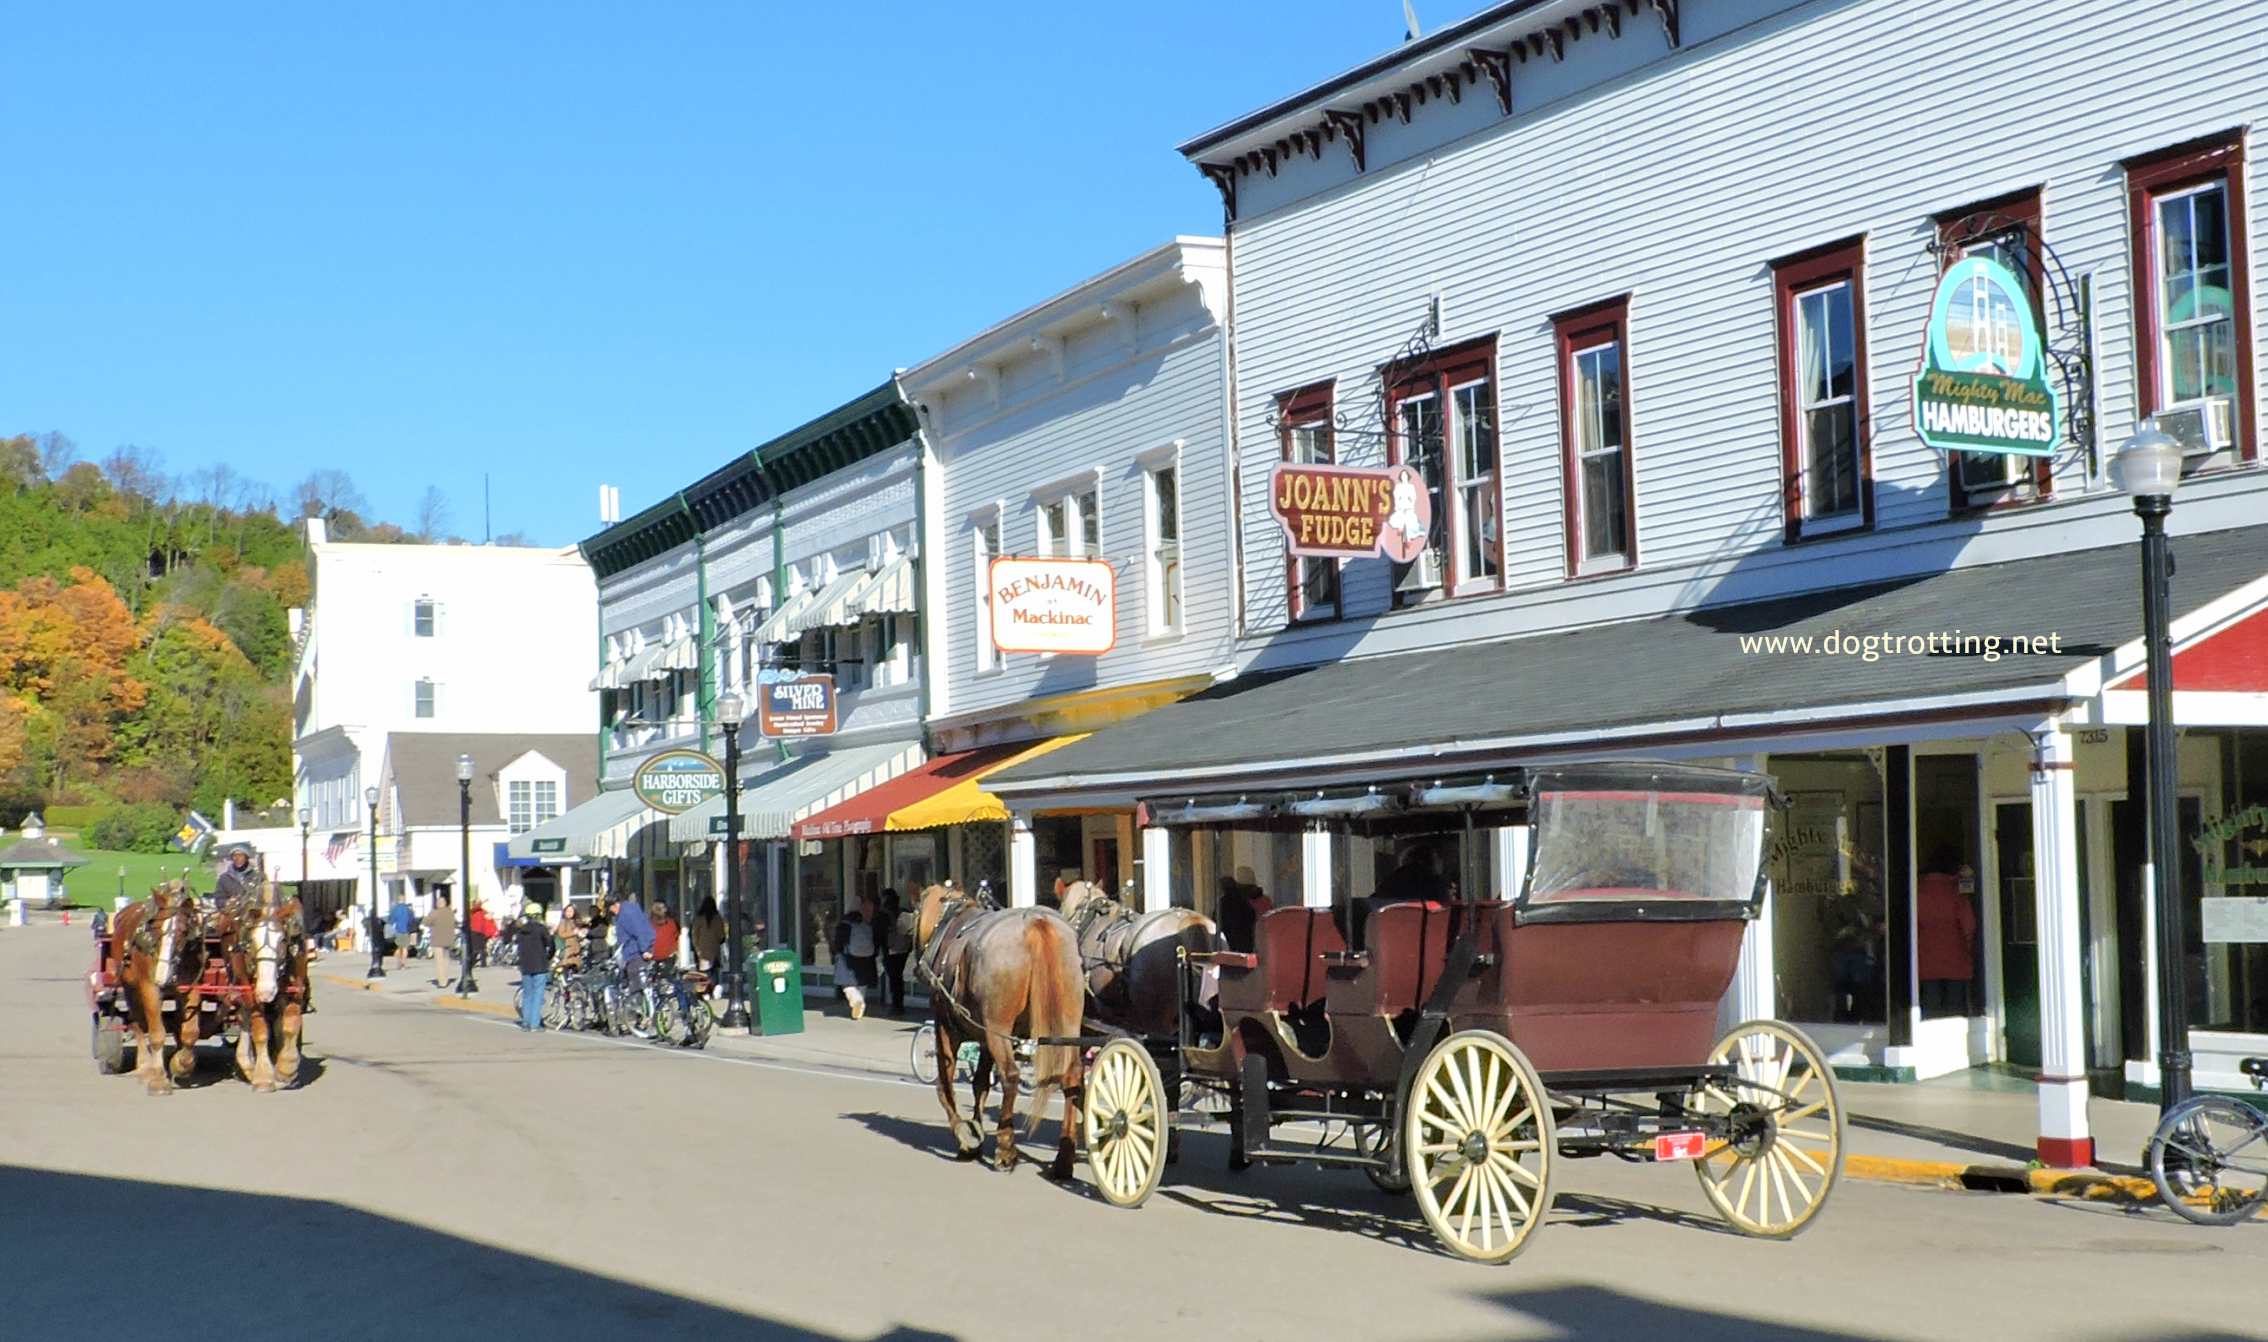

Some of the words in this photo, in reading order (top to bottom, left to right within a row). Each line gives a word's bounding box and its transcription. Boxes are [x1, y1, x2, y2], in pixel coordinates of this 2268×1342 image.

[1927, 373, 2000, 404] Mighty
[1999, 380, 2047, 405] Mac
[1922, 400, 2053, 442] HAMBURGERS
[1278, 471, 1392, 514] JOANN'S
[1299, 513, 1375, 546] FUDGE
[998, 573, 1107, 606] BENJAMIN
[1013, 608, 1094, 626] Mackinac
[773, 684, 824, 699] SILVER
[792, 695, 824, 710] MINE
[642, 772, 721, 791] HARBORSIDE
[662, 788, 703, 806] GIFTS
